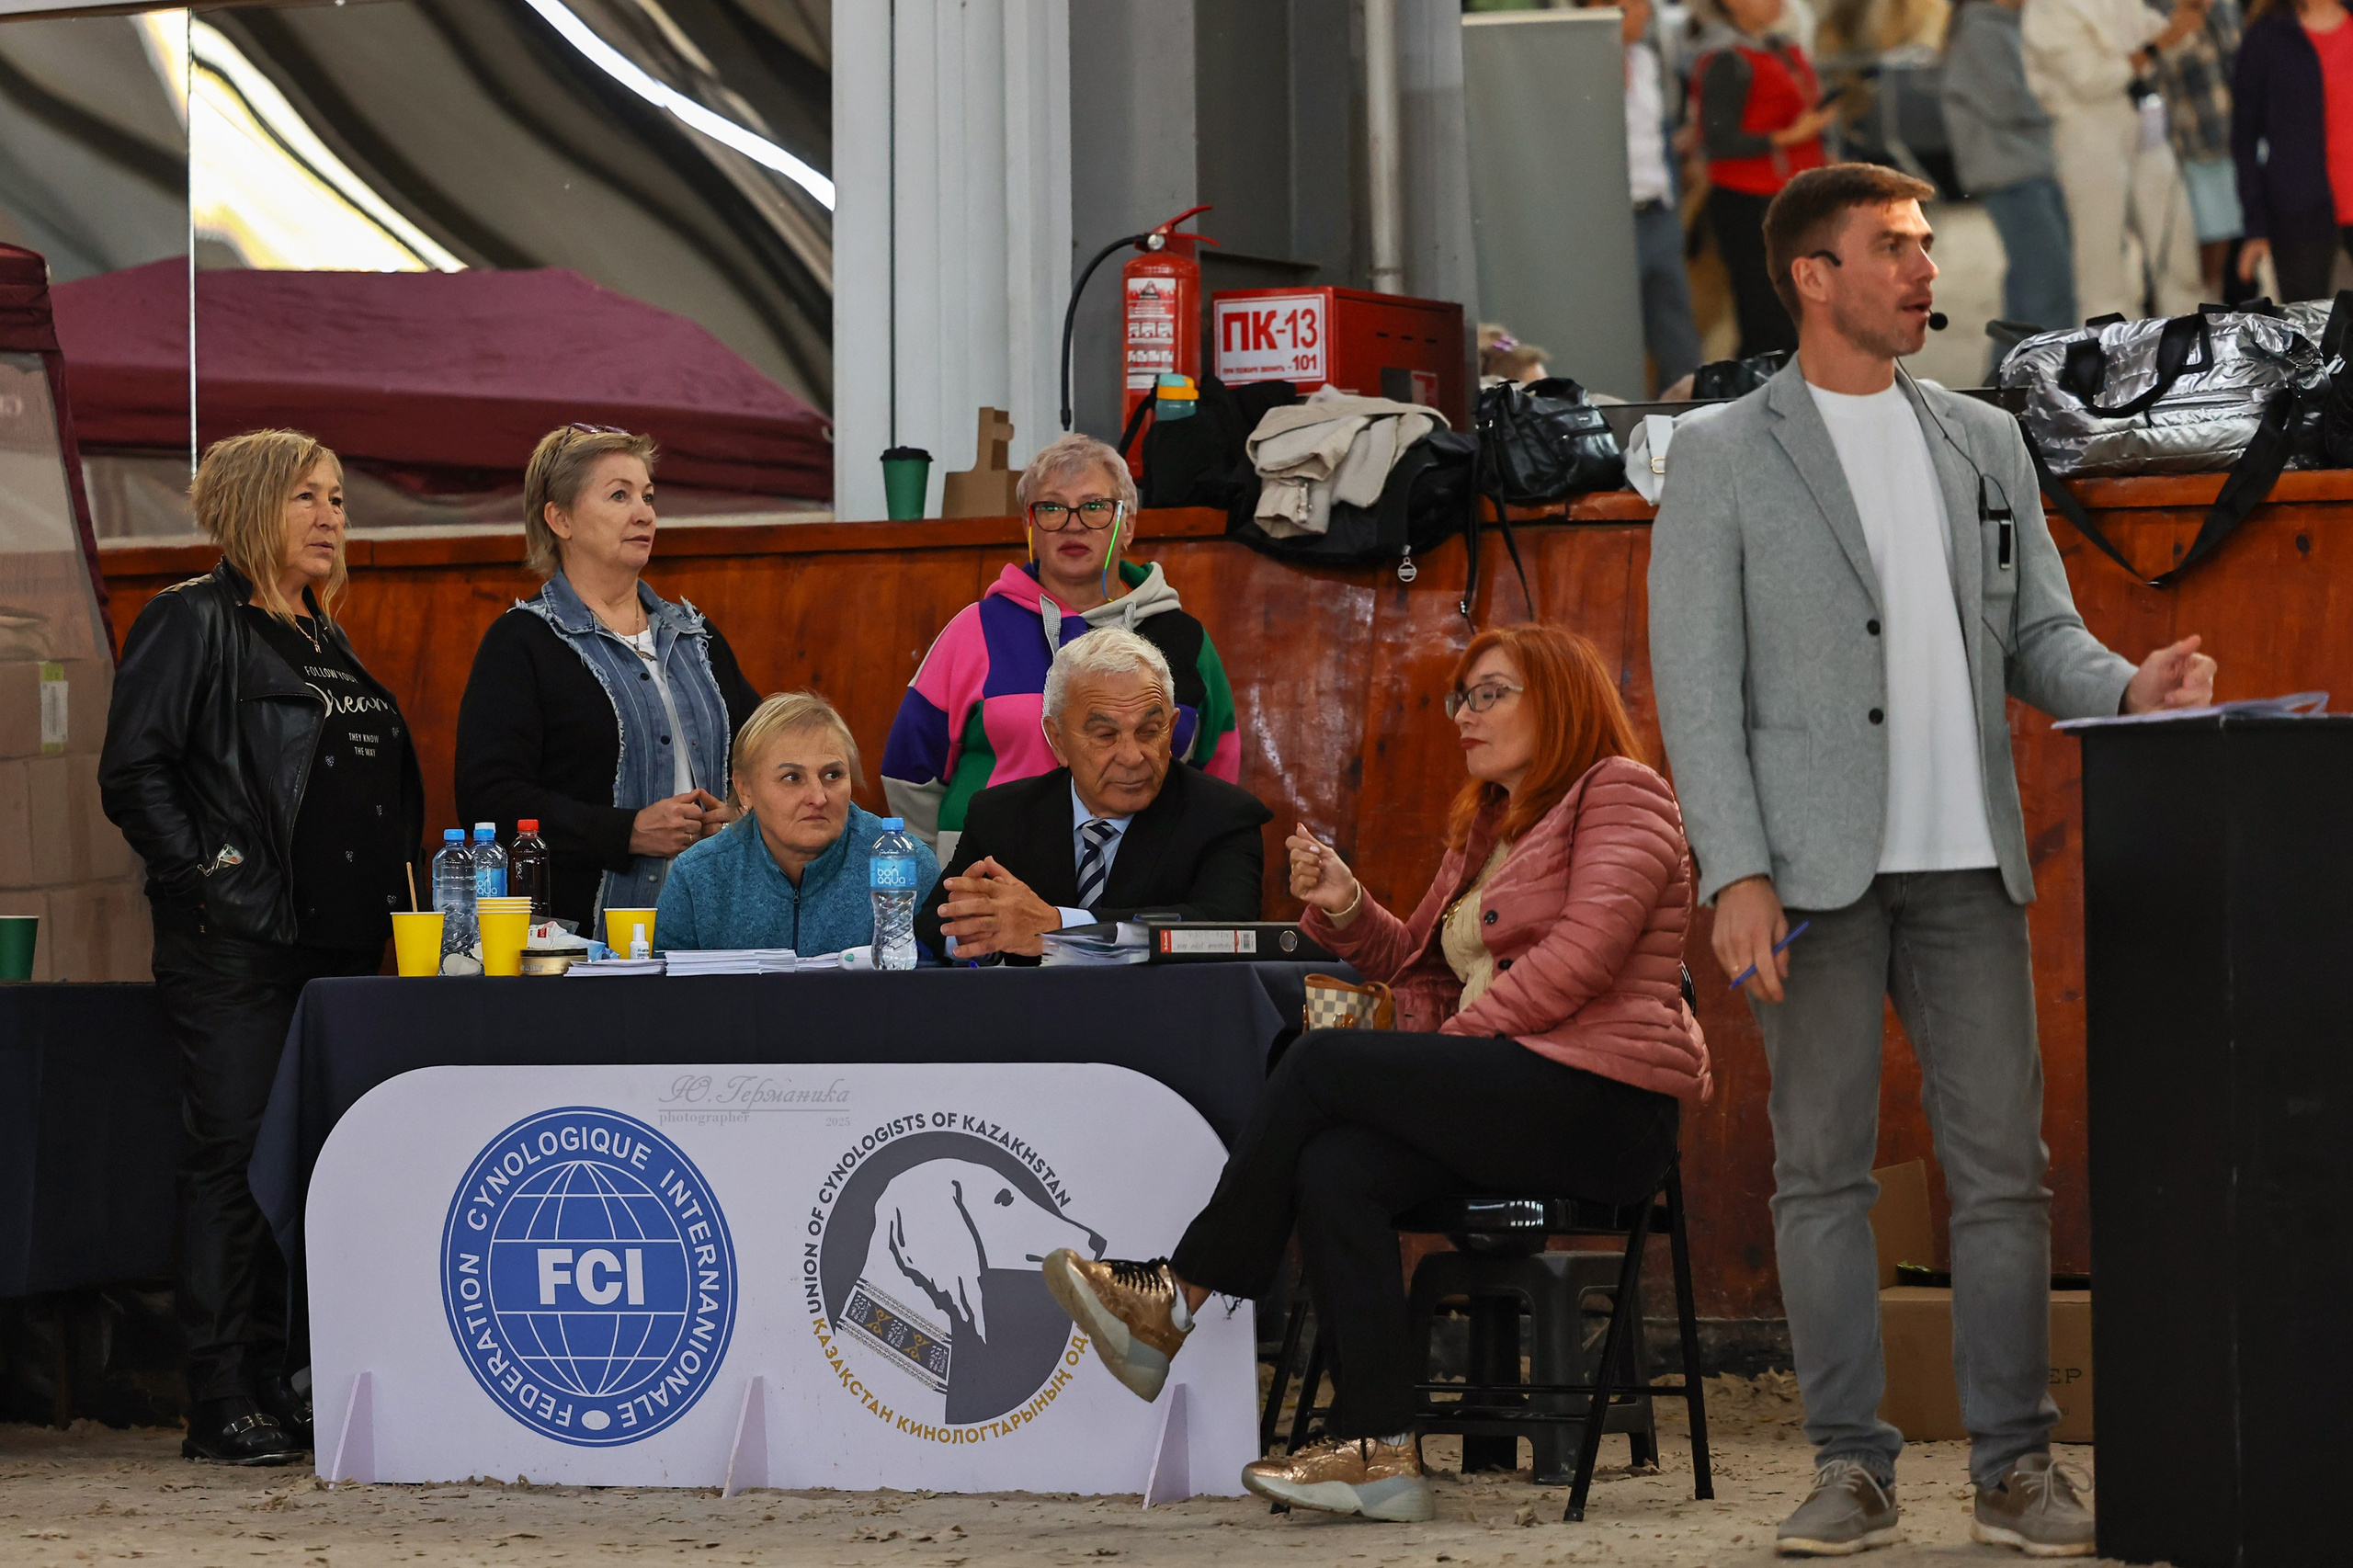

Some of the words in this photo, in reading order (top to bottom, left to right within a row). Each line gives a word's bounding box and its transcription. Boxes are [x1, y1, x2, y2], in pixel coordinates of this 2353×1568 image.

[1222, 308, 1318, 352] ПК-13
[303, 665, 338, 679] FOLLOW
[348, 732, 362, 743] THEY
[362, 733, 380, 744] KNOW
[354, 746, 365, 756] THE
[365, 747, 377, 757] WAY
[877, 876, 906, 887] aqua
[931, 1111, 958, 1128] OF
[466, 1126, 652, 1233] CYNOLOGIQUE
[818, 1112, 926, 1205] CYNOLOGISTS
[963, 1114, 1072, 1209] KAZAKHSTAN
[807, 1206, 825, 1237] OF
[537, 1248, 645, 1305] FCI
[616, 1168, 721, 1429] INTERNANIONALE
[803, 1242, 823, 1315] UNION
[458, 1252, 574, 1428] FEDERATION
[812, 1317, 894, 1424] ҚАЗАҚСТАН
[895, 1368, 1074, 1445] КИНОЛОГТАРЫНЫҢ
[1065, 1324, 1090, 1368] ОД
